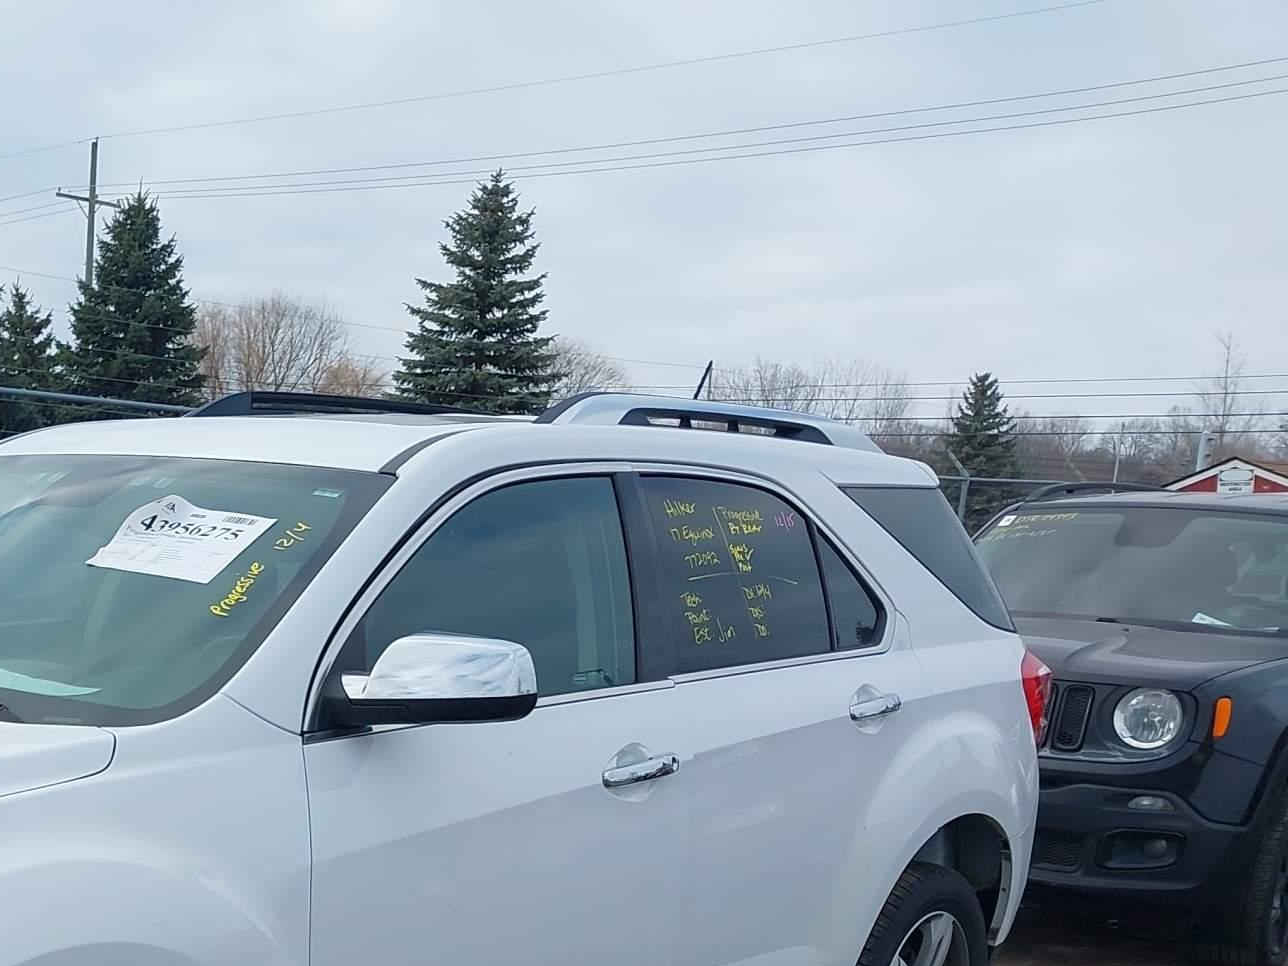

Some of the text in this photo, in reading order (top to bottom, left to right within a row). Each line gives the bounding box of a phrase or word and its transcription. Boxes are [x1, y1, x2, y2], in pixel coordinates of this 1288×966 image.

[140, 514, 246, 541] 43956275
[273, 522, 312, 550] 12/4
[209, 561, 265, 616] Progressive
